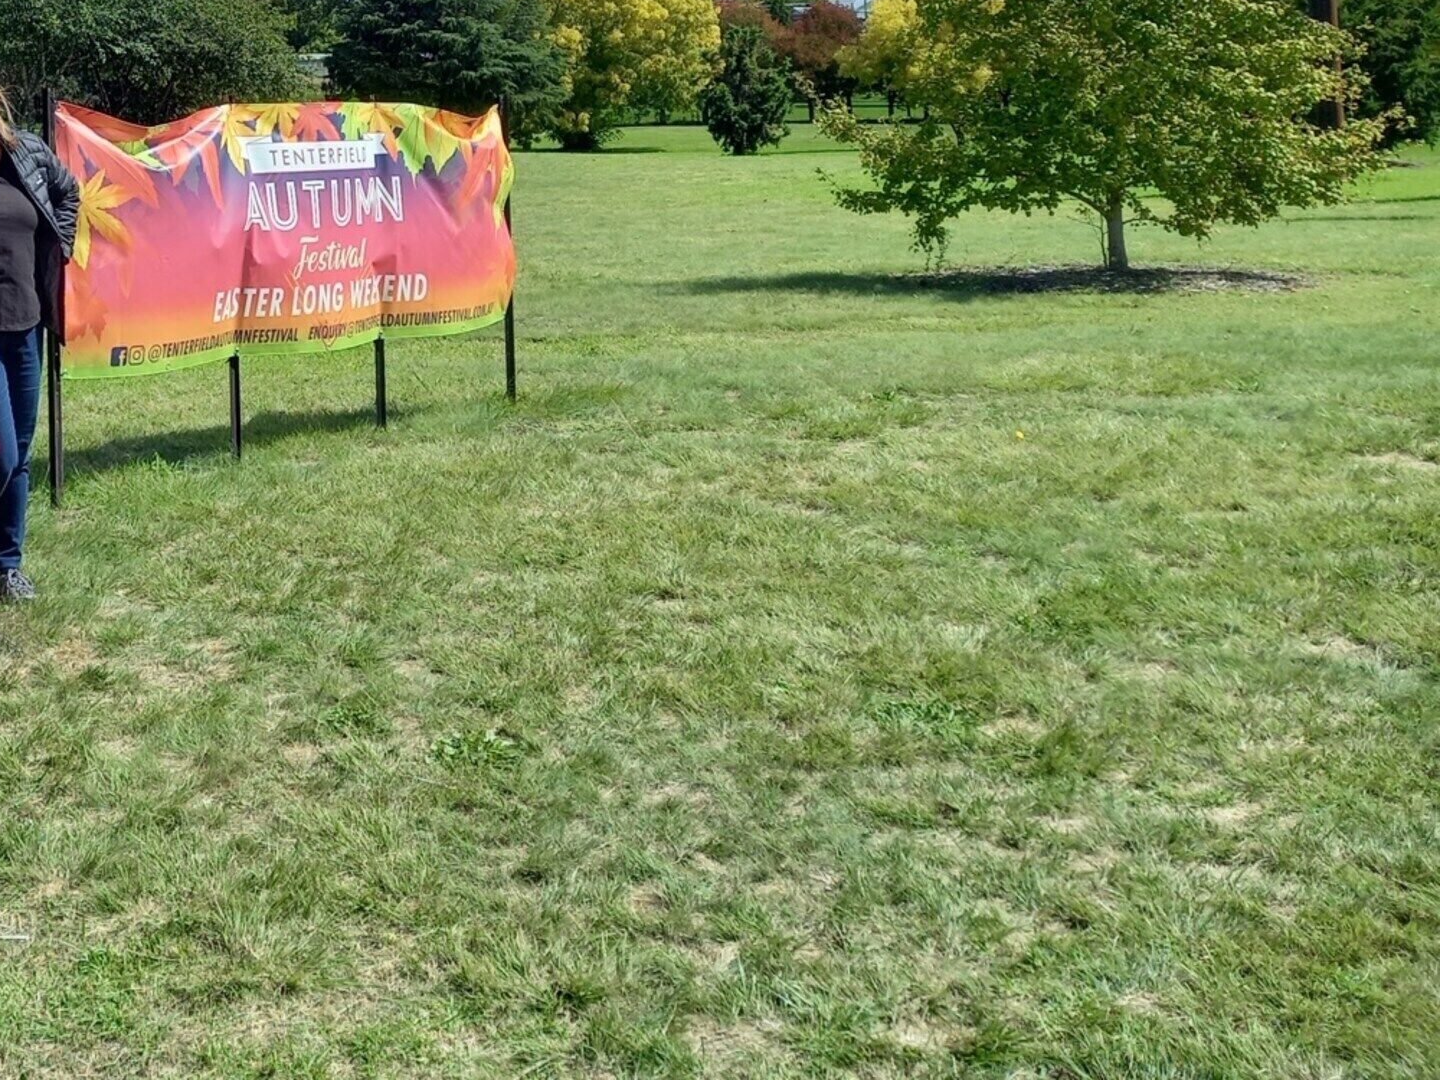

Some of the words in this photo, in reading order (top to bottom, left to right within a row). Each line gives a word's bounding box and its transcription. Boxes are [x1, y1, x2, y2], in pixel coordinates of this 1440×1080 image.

[269, 146, 368, 167] TENTERFIELD
[243, 175, 404, 232] AUTUMN
[293, 235, 367, 280] Festival
[213, 287, 284, 323] EASTER
[291, 281, 344, 317] LONG
